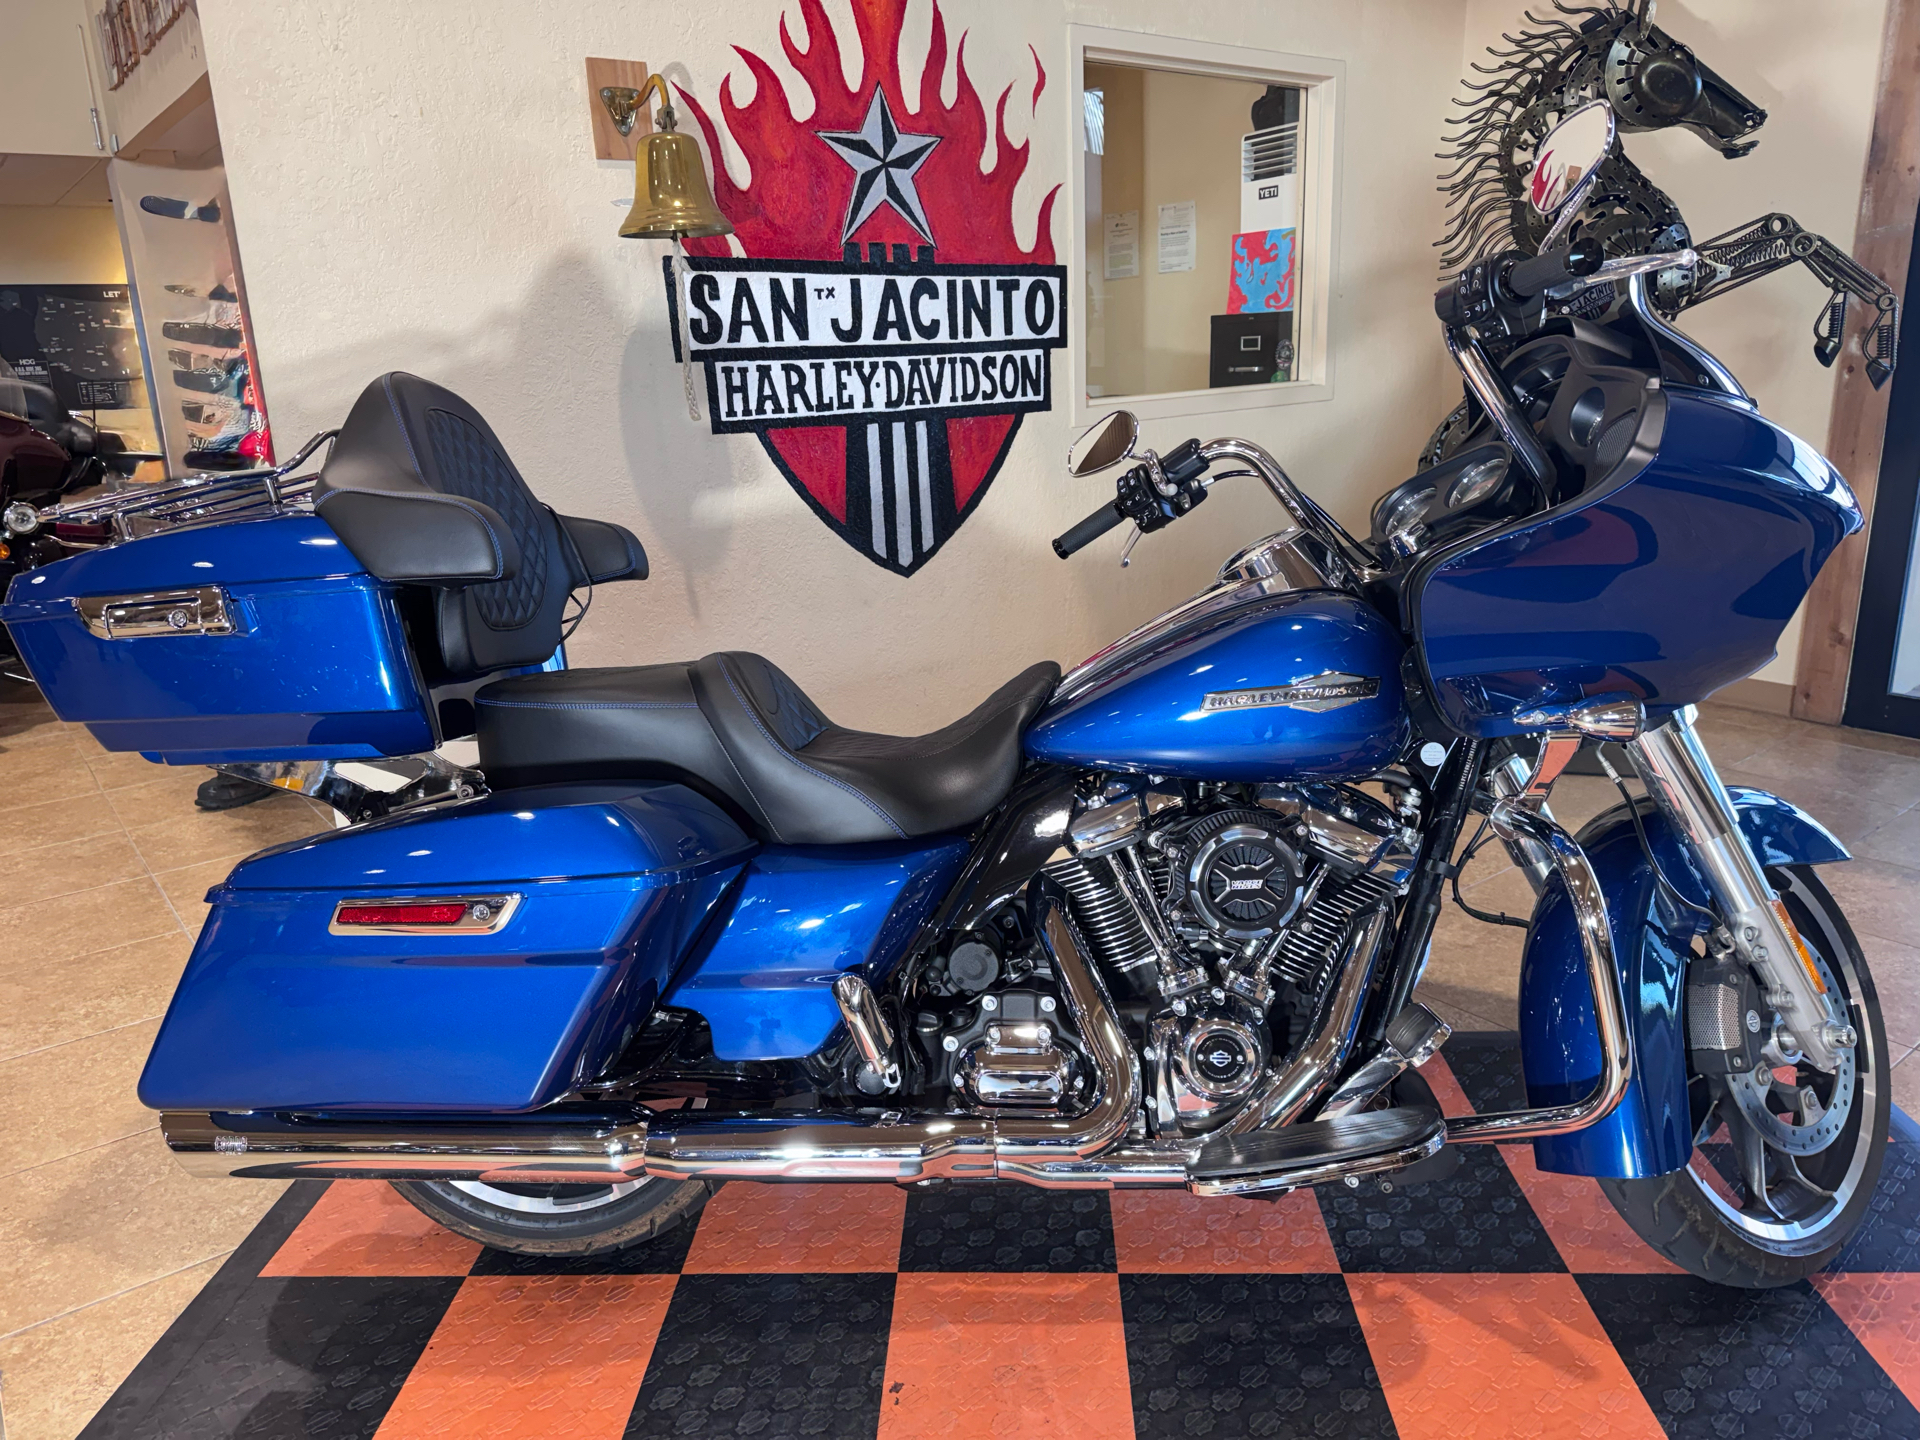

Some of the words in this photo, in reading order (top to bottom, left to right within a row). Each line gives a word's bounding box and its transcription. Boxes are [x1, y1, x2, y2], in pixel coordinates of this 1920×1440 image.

[1260, 187, 1278, 198] YETI
[689, 273, 810, 345] SAN
[814, 286, 836, 300] TX
[830, 277, 1055, 343] JACINTO
